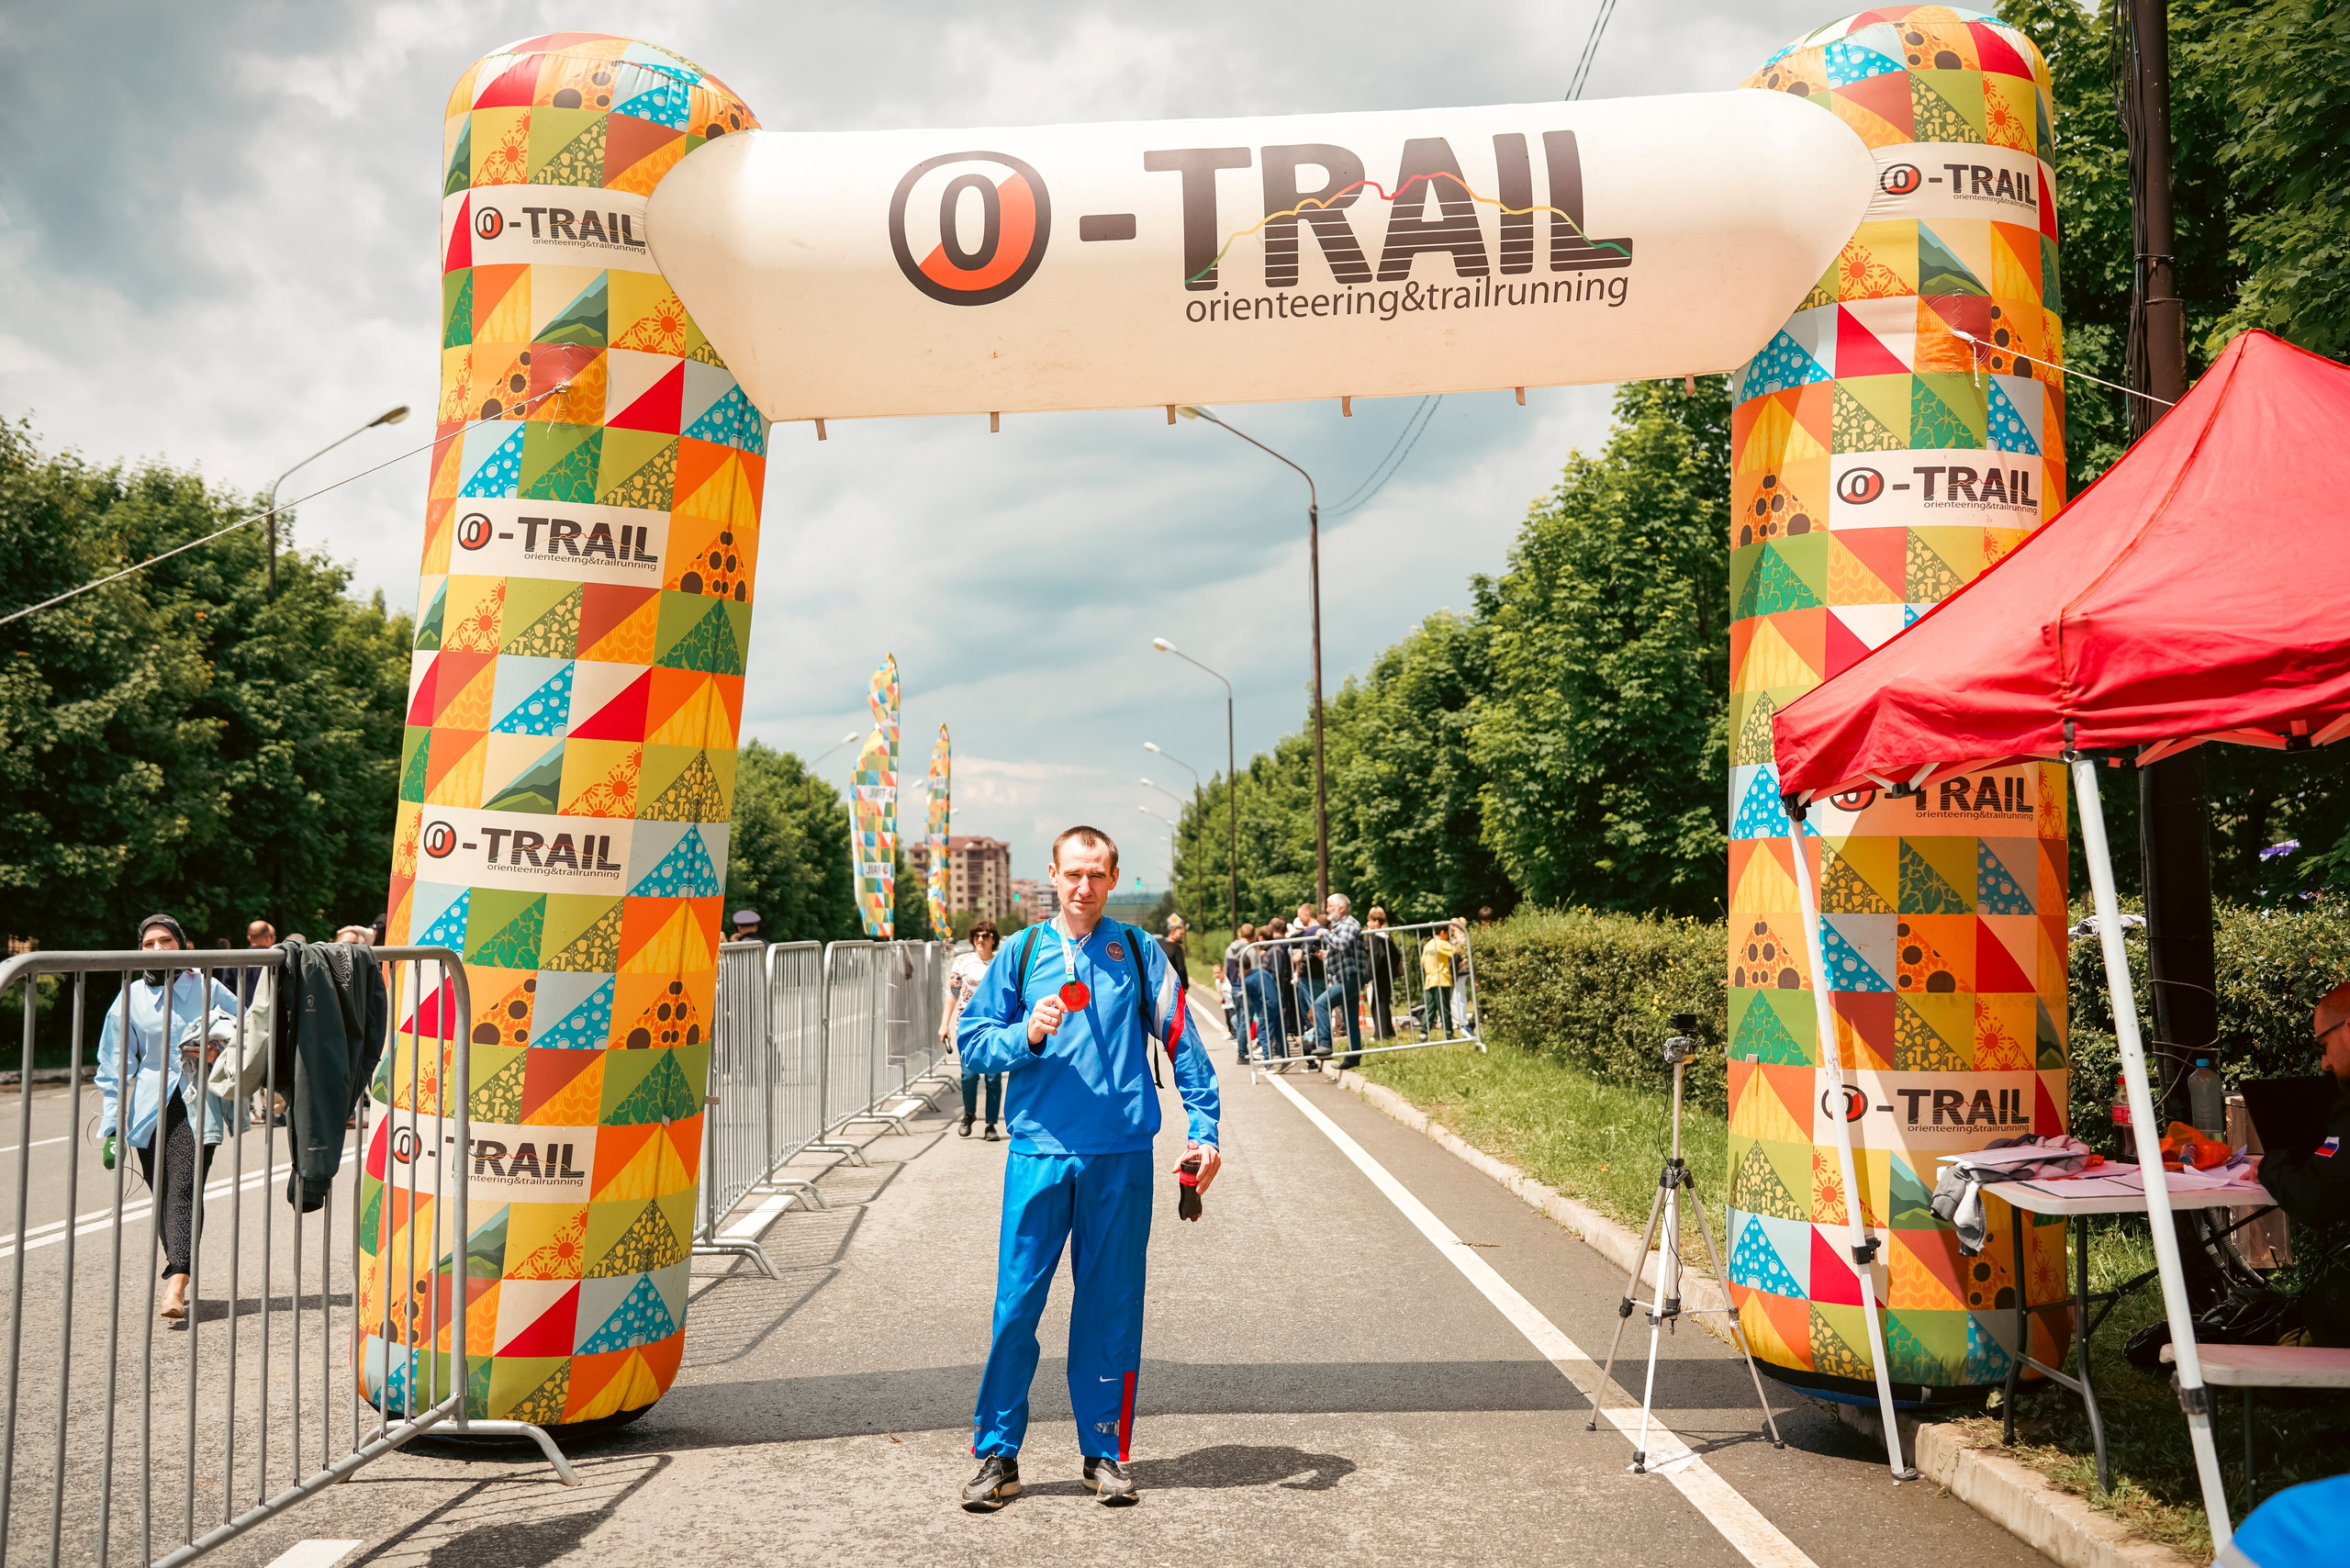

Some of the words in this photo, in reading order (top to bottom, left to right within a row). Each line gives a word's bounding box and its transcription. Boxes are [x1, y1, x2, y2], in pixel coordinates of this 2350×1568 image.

[1953, 193, 2036, 213] orienteering&trailrunning
[533, 238, 645, 254] orienteering&trailrunning
[1185, 274, 1628, 322] orienteering&trailrunning
[1924, 500, 2037, 515] orienteering&trailrunning
[524, 553, 656, 571] orienteering&trailrunning
[1916, 811, 2033, 821] orienteering&trailrunning
[487, 863, 620, 879] orienteering&trailrunning
[1908, 1124, 2030, 1134] orienteering&trailrunning
[452, 1172, 584, 1186] enteering&trailrunning
